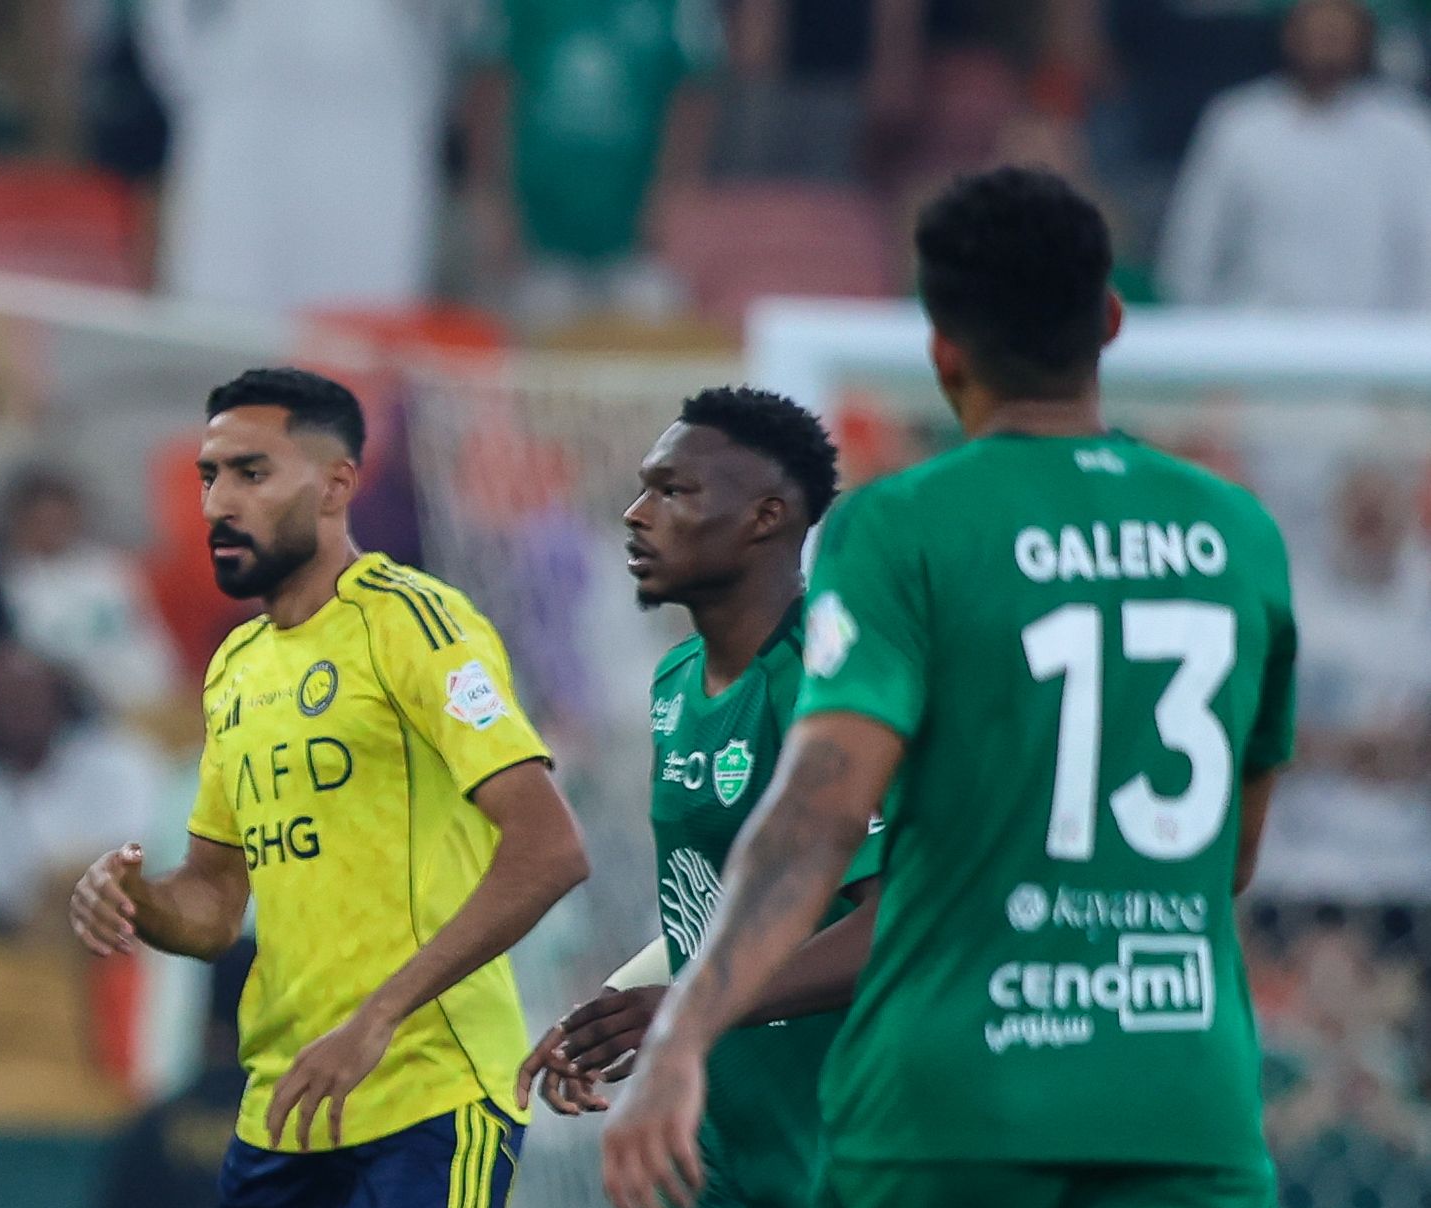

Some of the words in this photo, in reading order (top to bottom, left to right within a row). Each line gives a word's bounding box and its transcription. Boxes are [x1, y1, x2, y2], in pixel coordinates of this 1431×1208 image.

[1015, 520, 1228, 583] GALENO
[1020, 599, 1237, 864] 13
[235, 736, 353, 810] AFD
[243, 816, 321, 872] SHG
